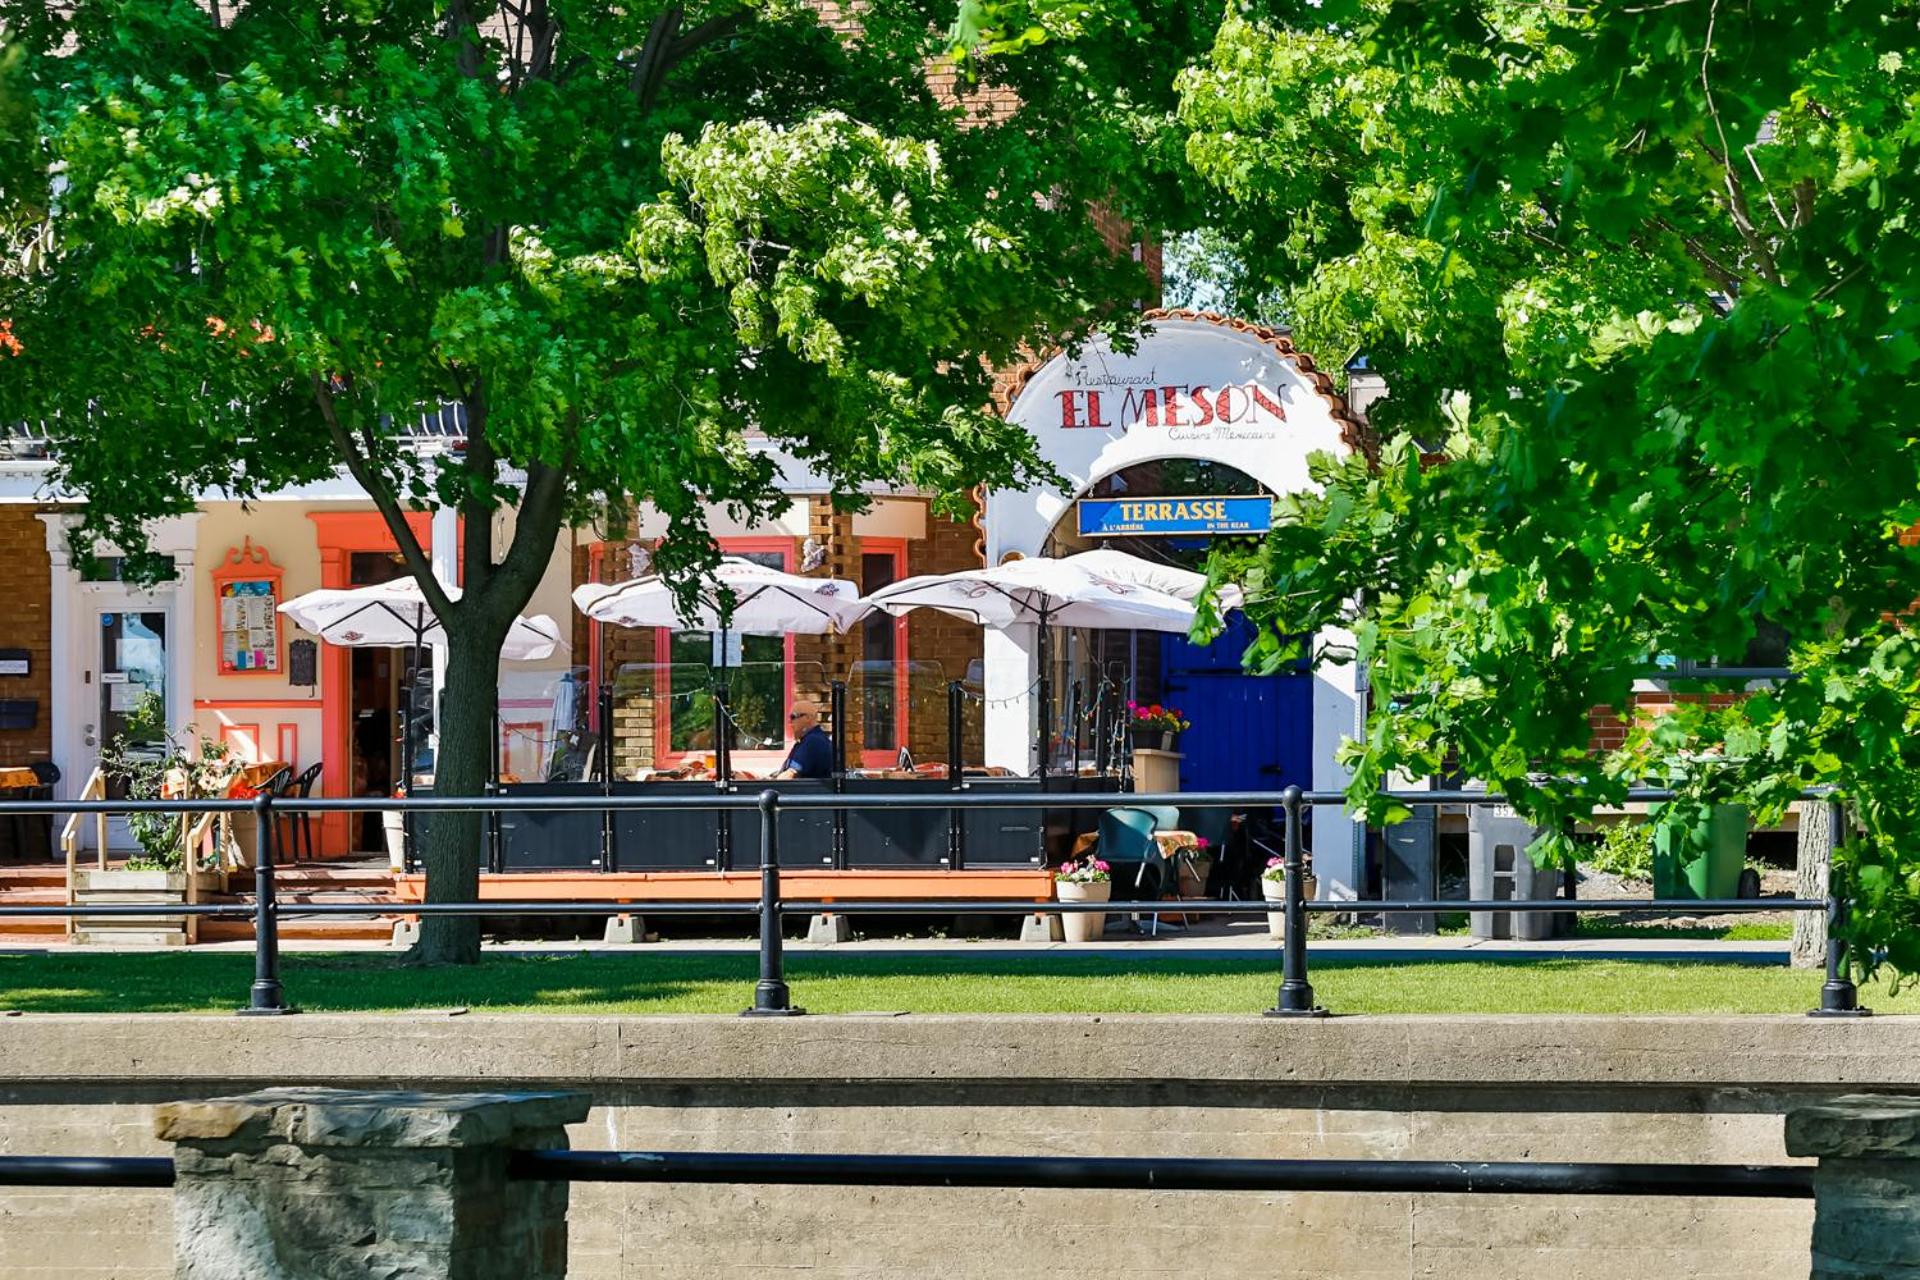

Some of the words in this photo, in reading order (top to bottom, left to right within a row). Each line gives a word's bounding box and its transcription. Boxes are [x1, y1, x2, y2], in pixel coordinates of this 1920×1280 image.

[1074, 365, 1158, 386] Restaurant
[1054, 387, 1112, 429] EL
[1120, 383, 1288, 433] MESON
[1167, 426, 1212, 440] Cuisine
[1119, 500, 1228, 522] TERRASSE
[1206, 521, 1216, 530] IN
[1216, 521, 1230, 530] THE
[1231, 521, 1249, 530] REAR
